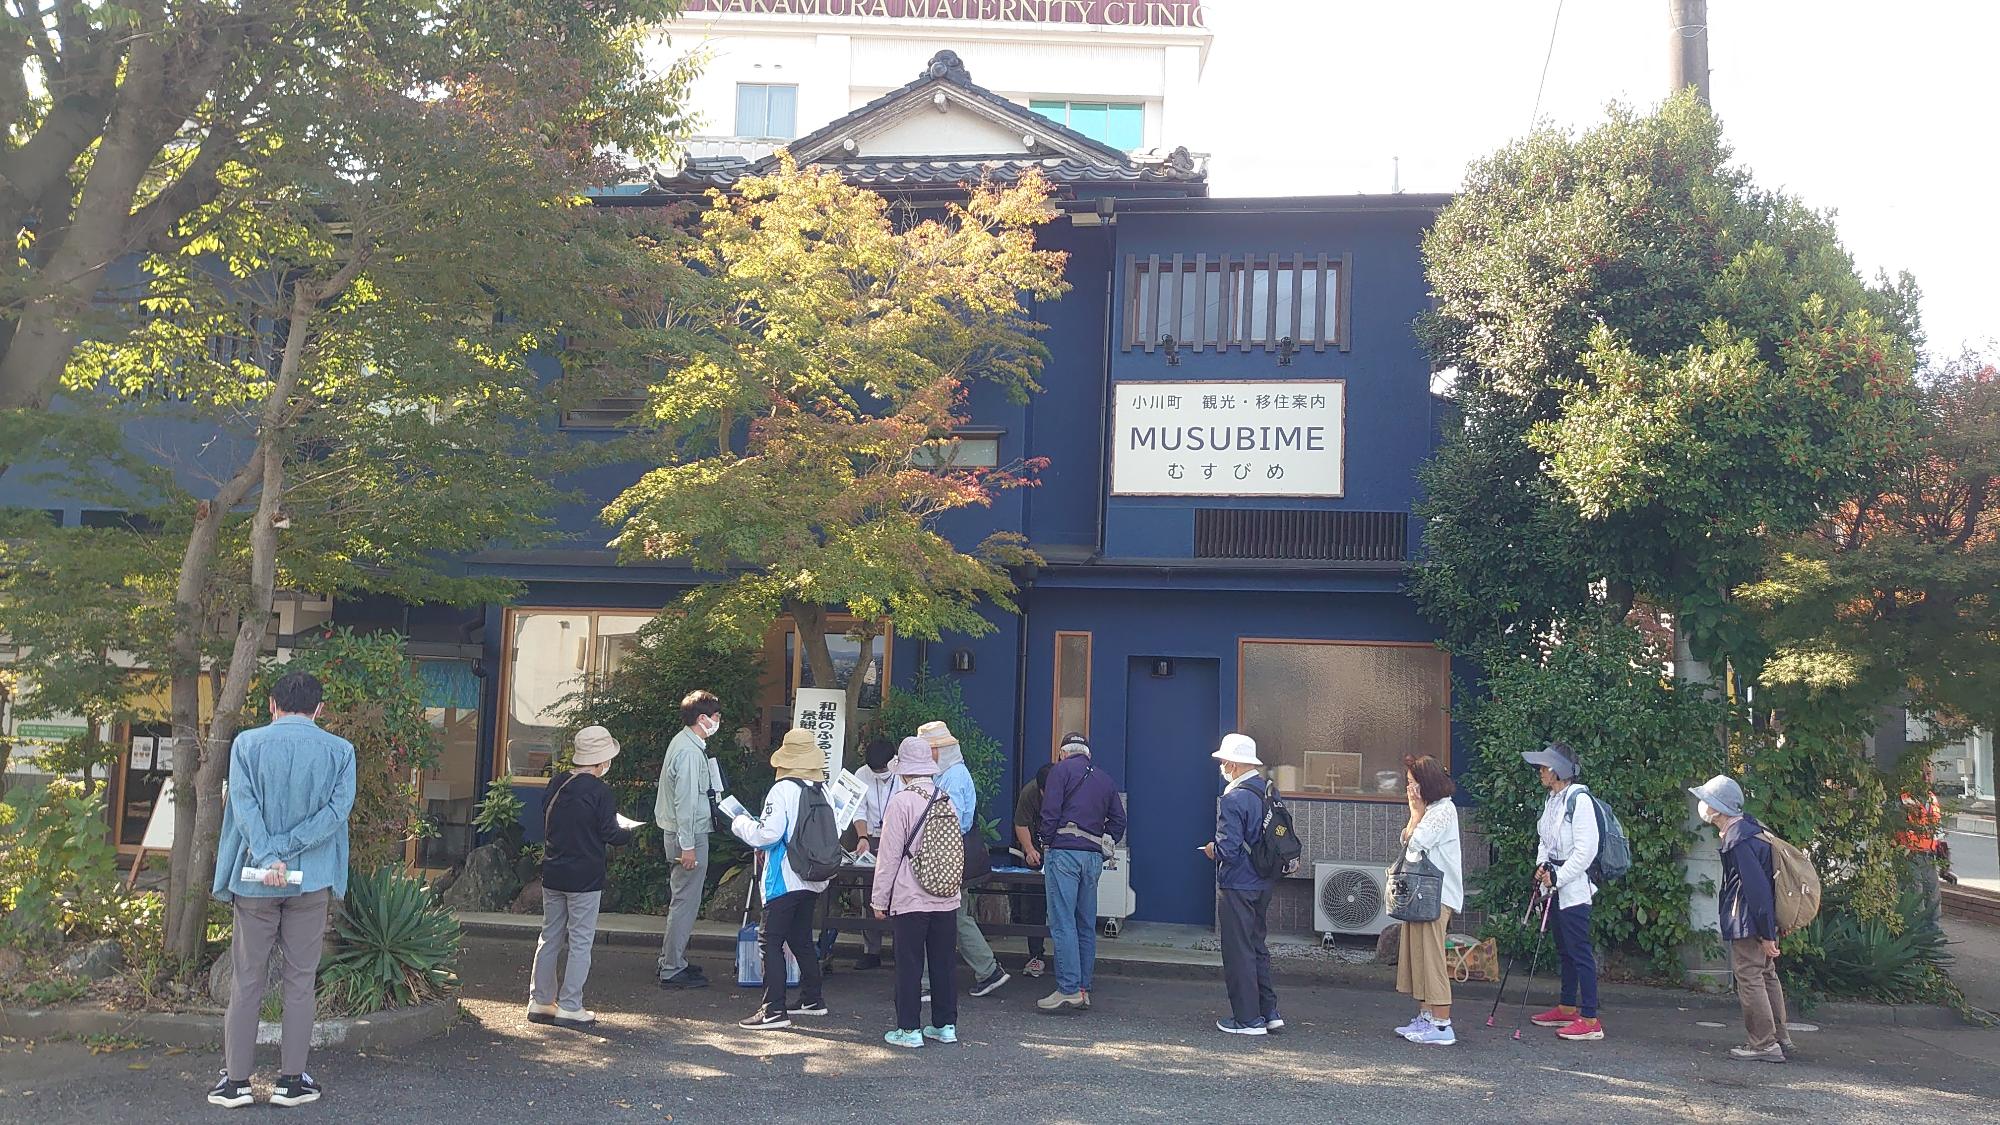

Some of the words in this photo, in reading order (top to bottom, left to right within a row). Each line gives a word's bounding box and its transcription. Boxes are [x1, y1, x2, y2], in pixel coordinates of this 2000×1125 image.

[703, 0, 889, 17] NAKAMURA
[904, 0, 1097, 25] MATERNITY
[1103, 2, 1211, 29] CLINIC
[1132, 394, 1183, 410] 小川町
[1202, 393, 1326, 410] 観光・移住案内
[1130, 426, 1325, 451] MUSUBIME
[1167, 462, 1285, 480] むすびめ
[799, 709, 818, 735] 景観
